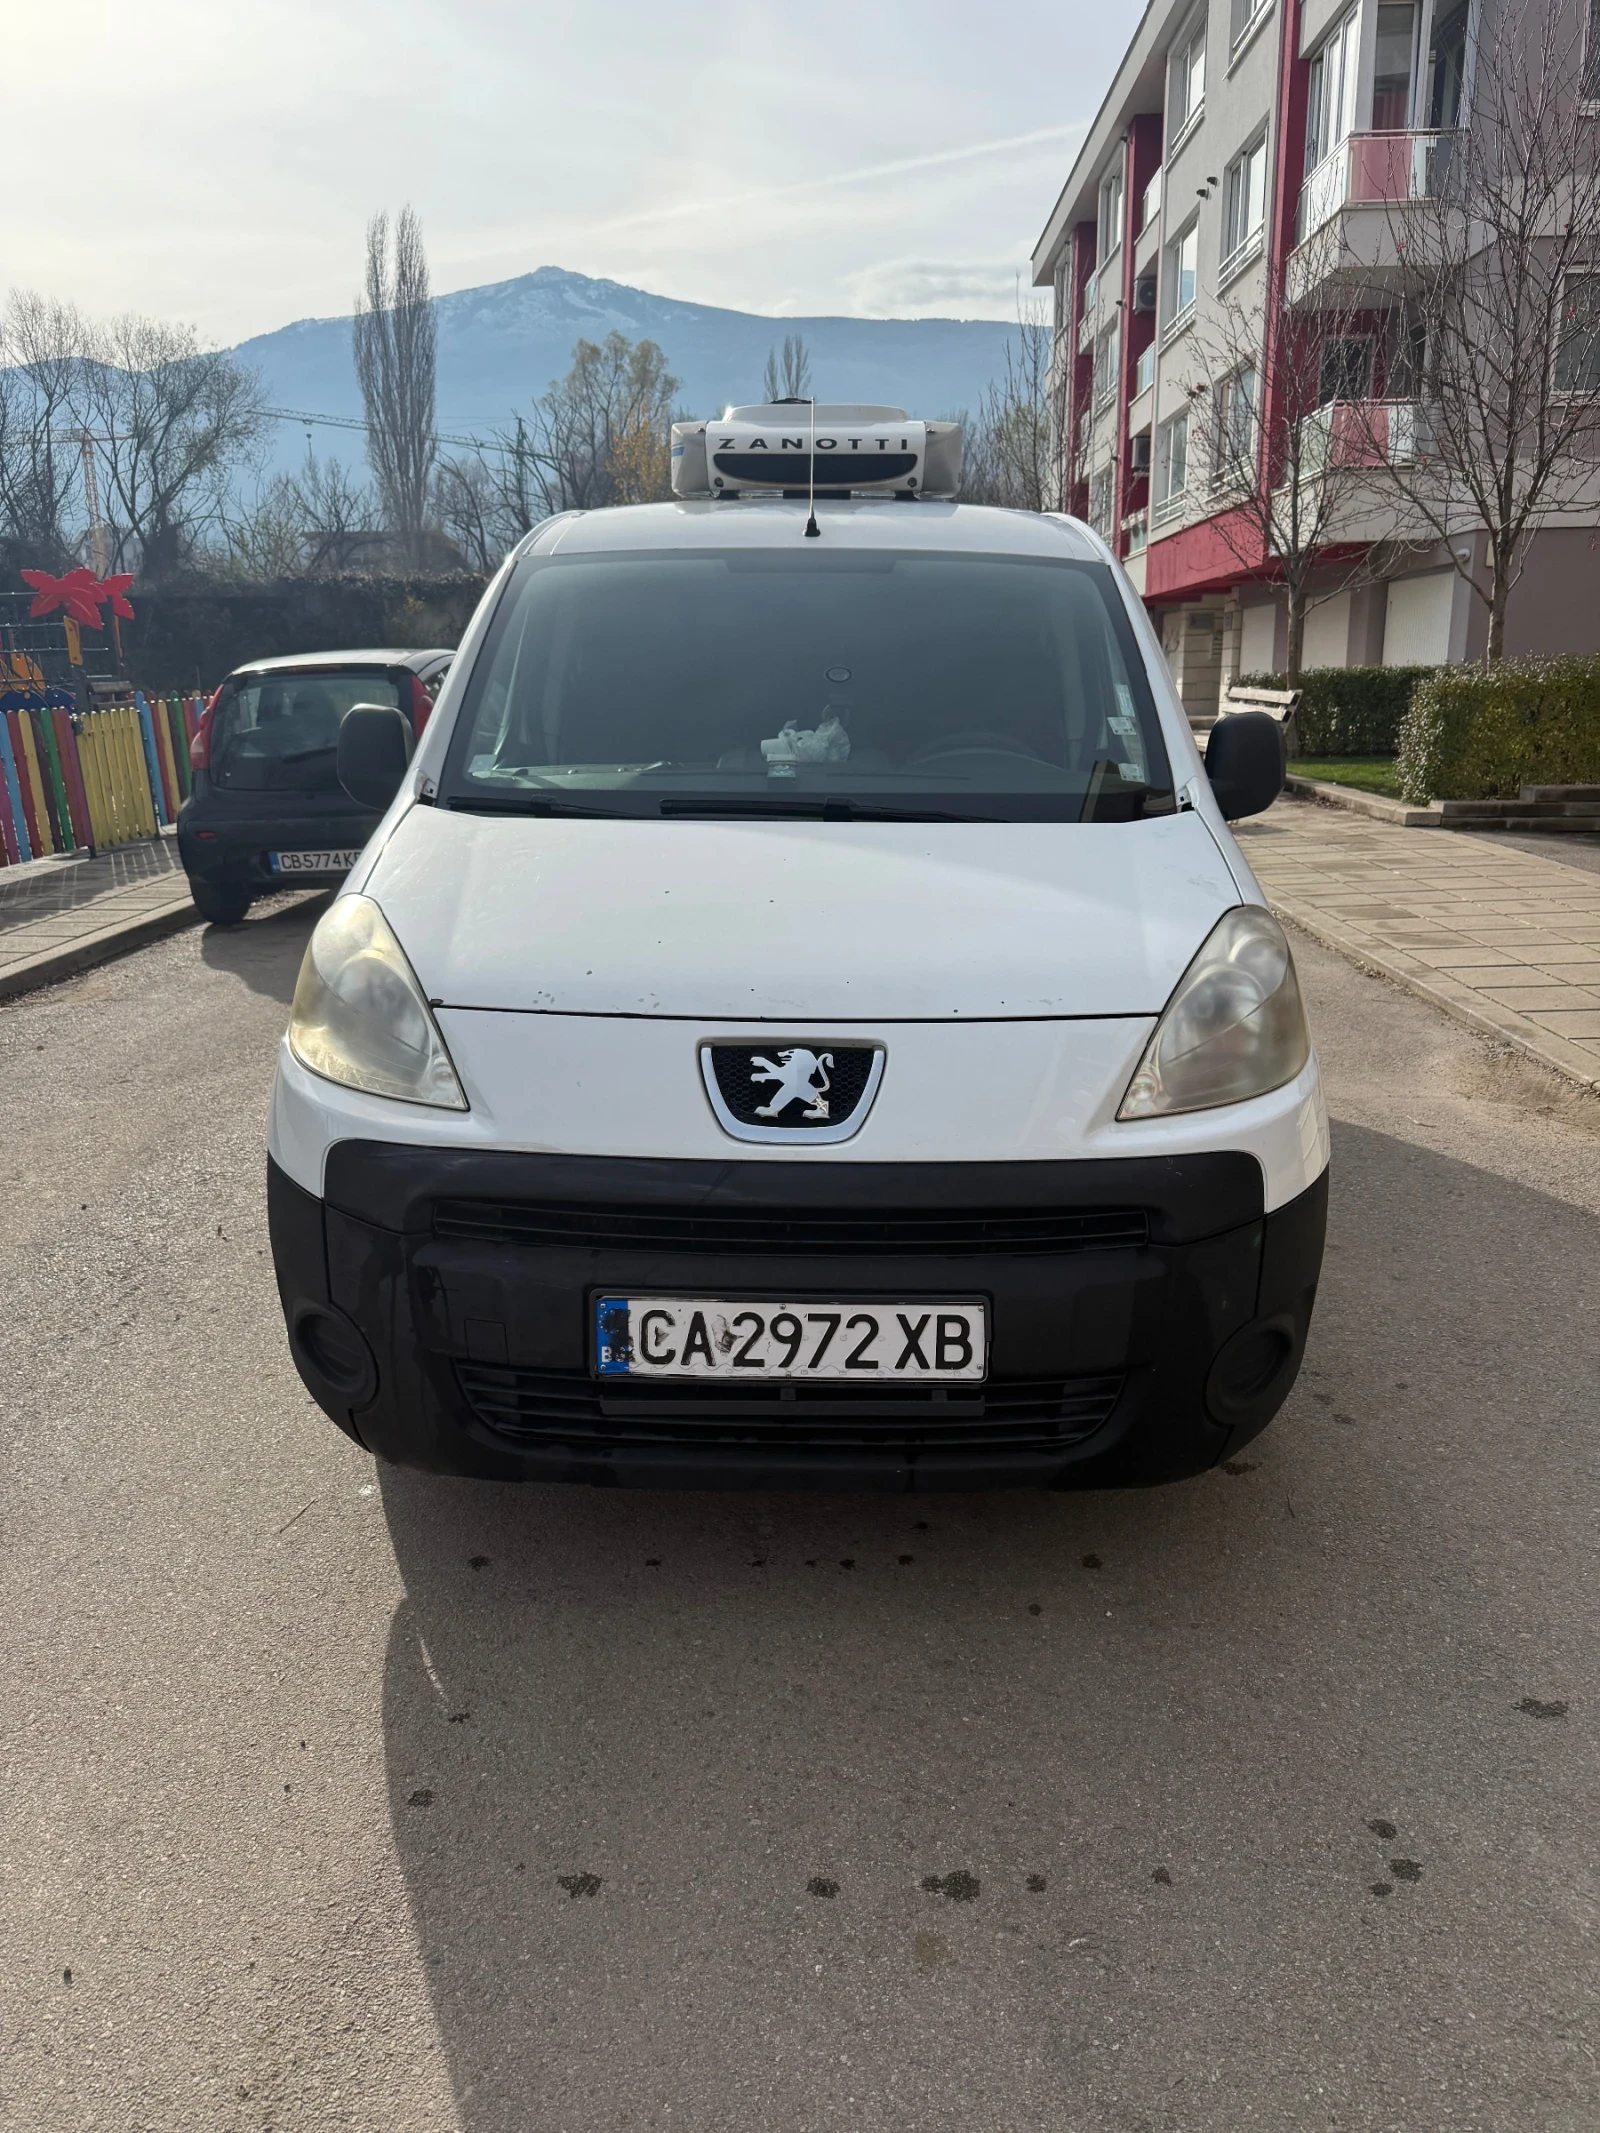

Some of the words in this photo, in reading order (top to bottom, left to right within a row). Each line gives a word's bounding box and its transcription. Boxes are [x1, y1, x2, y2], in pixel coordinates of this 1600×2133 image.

[718, 437, 907, 450] ZANOTTI
[640, 1309, 716, 1367] CA
[732, 1312, 879, 1369] 2972
[894, 1313, 973, 1370] XB
